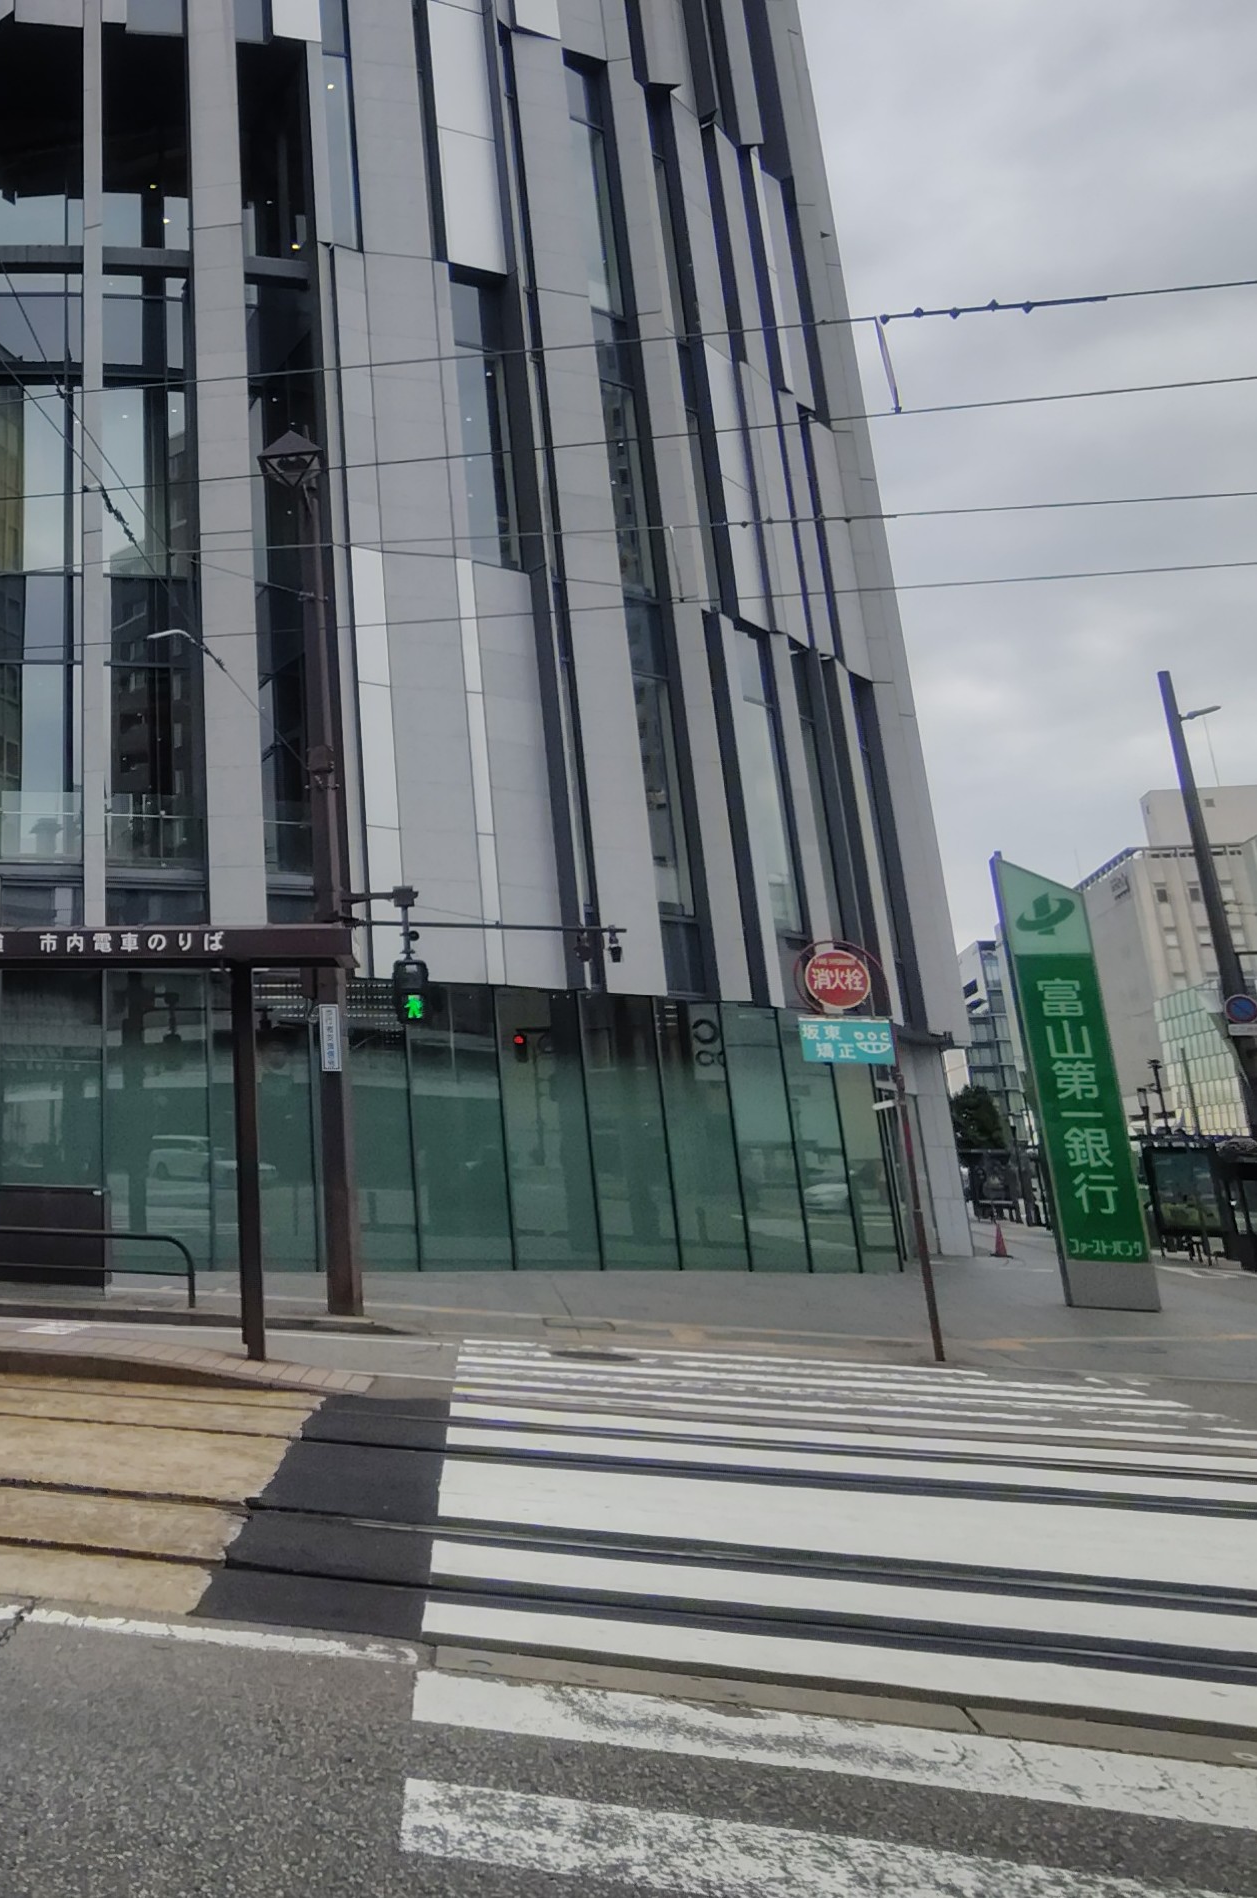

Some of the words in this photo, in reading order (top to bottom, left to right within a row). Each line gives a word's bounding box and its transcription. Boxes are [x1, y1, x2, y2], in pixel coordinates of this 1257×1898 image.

[39, 932, 225, 954] 市内電車のりば
[812, 969, 864, 991] 消火栓
[802, 1024, 841, 1040] 坂東
[817, 1043, 856, 1059] 矯正
[1037, 977, 1118, 1214] 富山第一銀行
